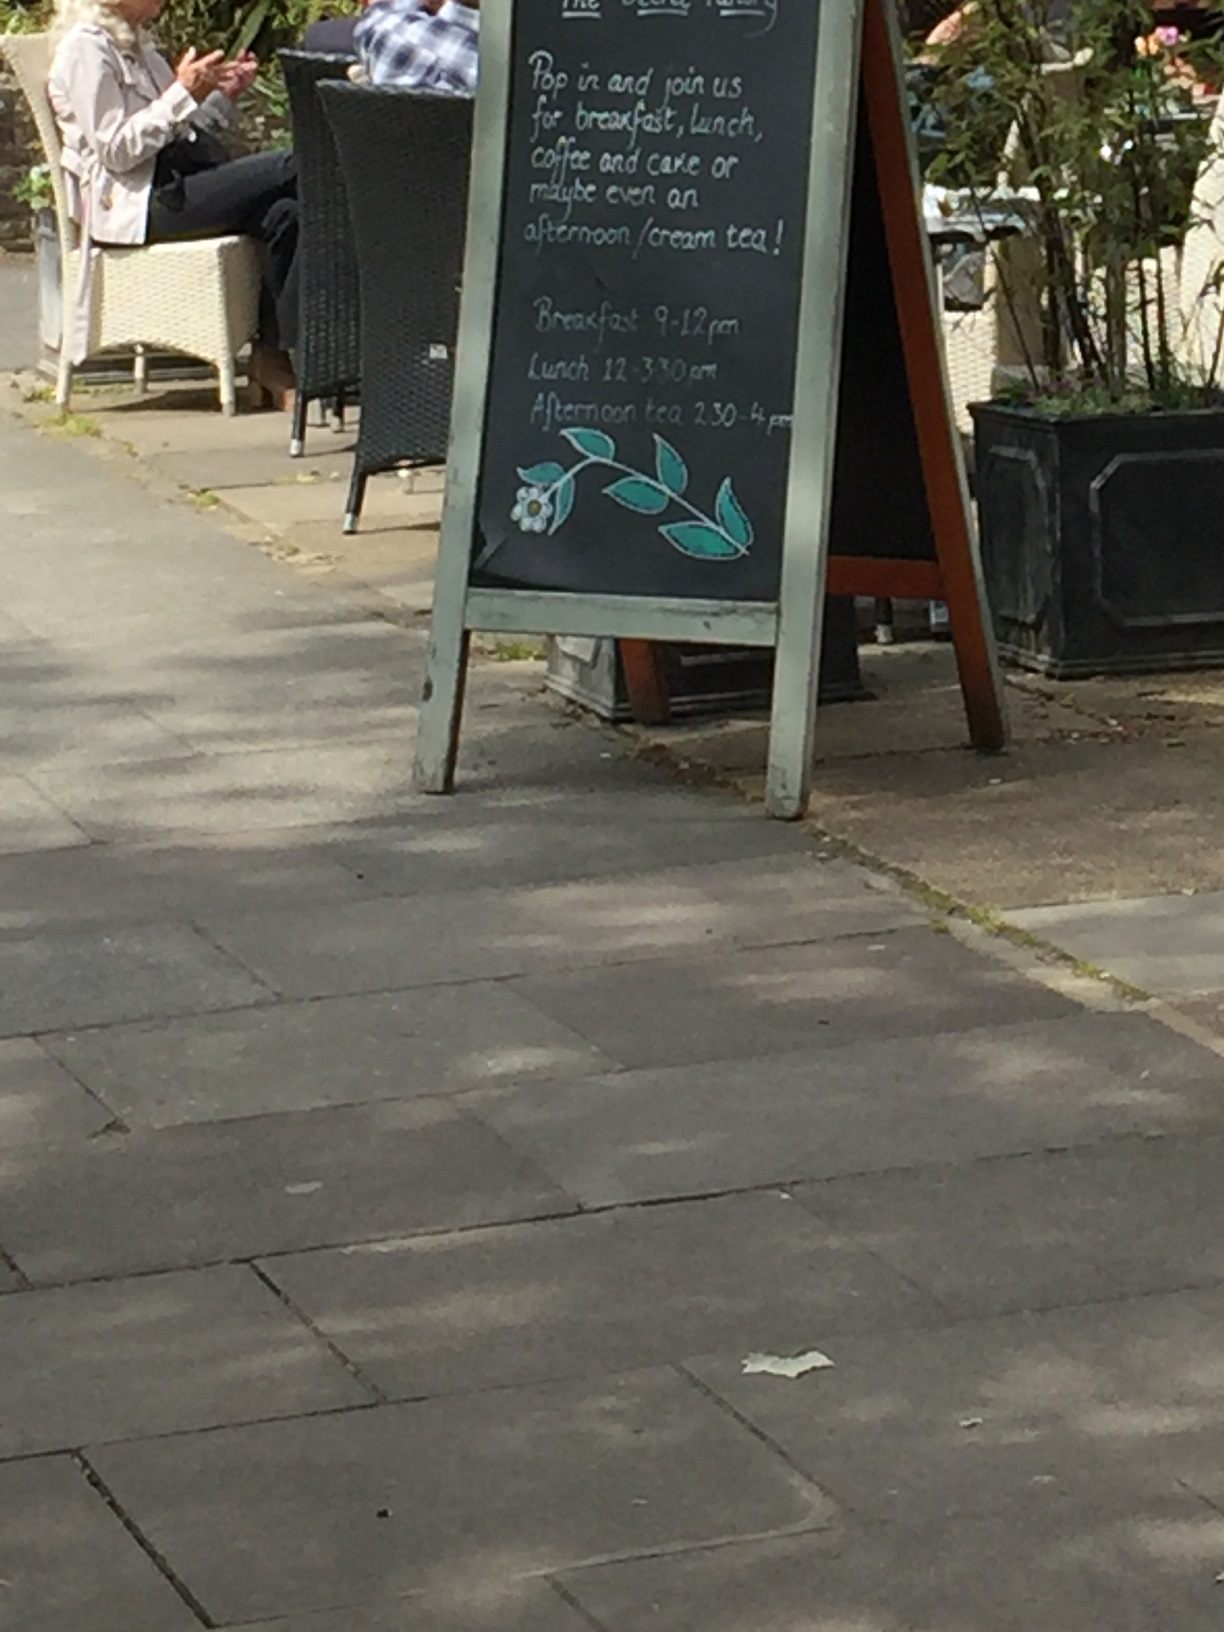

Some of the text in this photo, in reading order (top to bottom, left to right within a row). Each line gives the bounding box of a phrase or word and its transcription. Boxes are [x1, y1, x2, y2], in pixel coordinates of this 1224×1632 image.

[528, 50, 743, 109] Pop in and join us
[530, 95, 763, 150] for breakfast, lunch,
[531, 135, 739, 184] coffee and cake or
[529, 177, 699, 222] maybe even an
[533, 295, 638, 345] Breakfast
[527, 352, 590, 381] Lunch
[530, 391, 635, 432] Afternoon
[647, 398, 682, 423] tea
